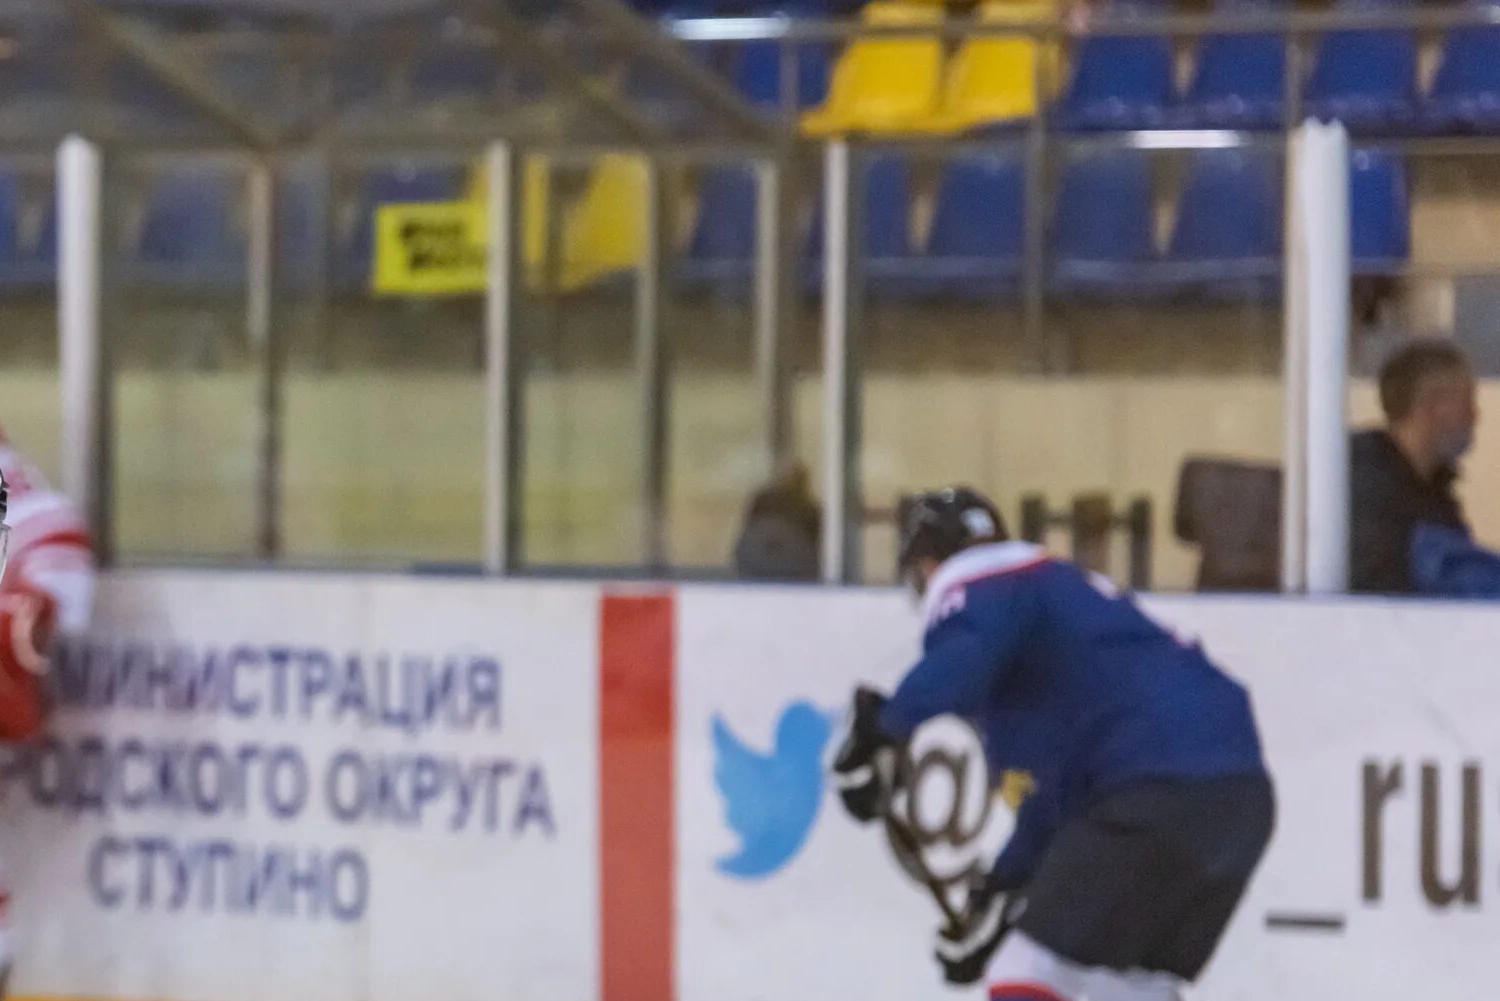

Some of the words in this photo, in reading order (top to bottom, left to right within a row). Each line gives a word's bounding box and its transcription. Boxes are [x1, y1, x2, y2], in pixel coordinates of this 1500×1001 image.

[50, 645, 504, 731] МИНИСТРАЦИЯ
[325, 748, 557, 840] ОКРУГА
[87, 836, 372, 924] СТУПИНО
